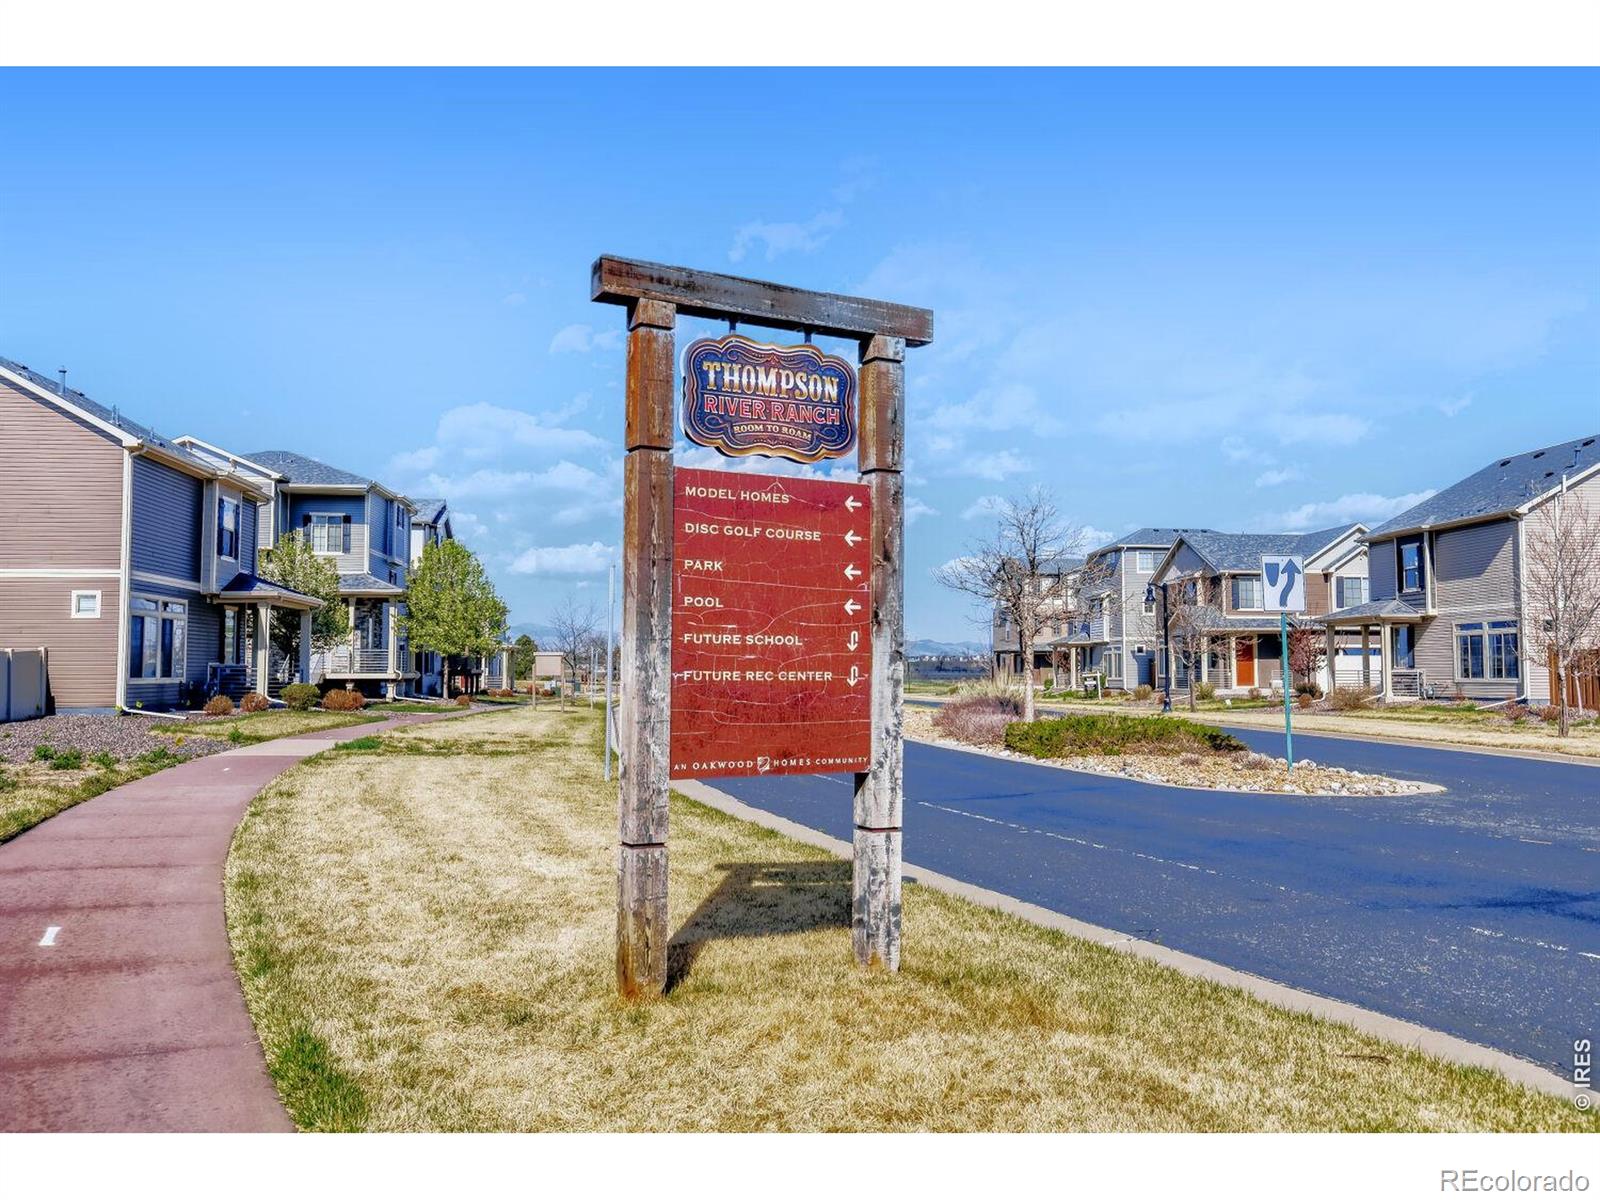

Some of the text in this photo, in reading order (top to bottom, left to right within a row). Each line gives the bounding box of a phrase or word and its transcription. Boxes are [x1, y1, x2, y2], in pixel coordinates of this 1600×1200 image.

[702, 361, 839, 404] THOMPSON
[704, 394, 840, 425] RIVER RANCH
[733, 424, 812, 441] ROOM TO ROAM
[685, 486, 790, 504] MODEL HOMES
[685, 523, 822, 542] DISC GOLF COURSE
[684, 560, 723, 571] PARK
[684, 597, 724, 608] POOL
[683, 633, 803, 645] FUTURE SCHOOL
[683, 671, 833, 681] FUTURE REC CENTER
[693, 760, 754, 770] OAKWOOD
[773, 758, 811, 767] HOMES
[815, 756, 868, 765] COMMUNITY
